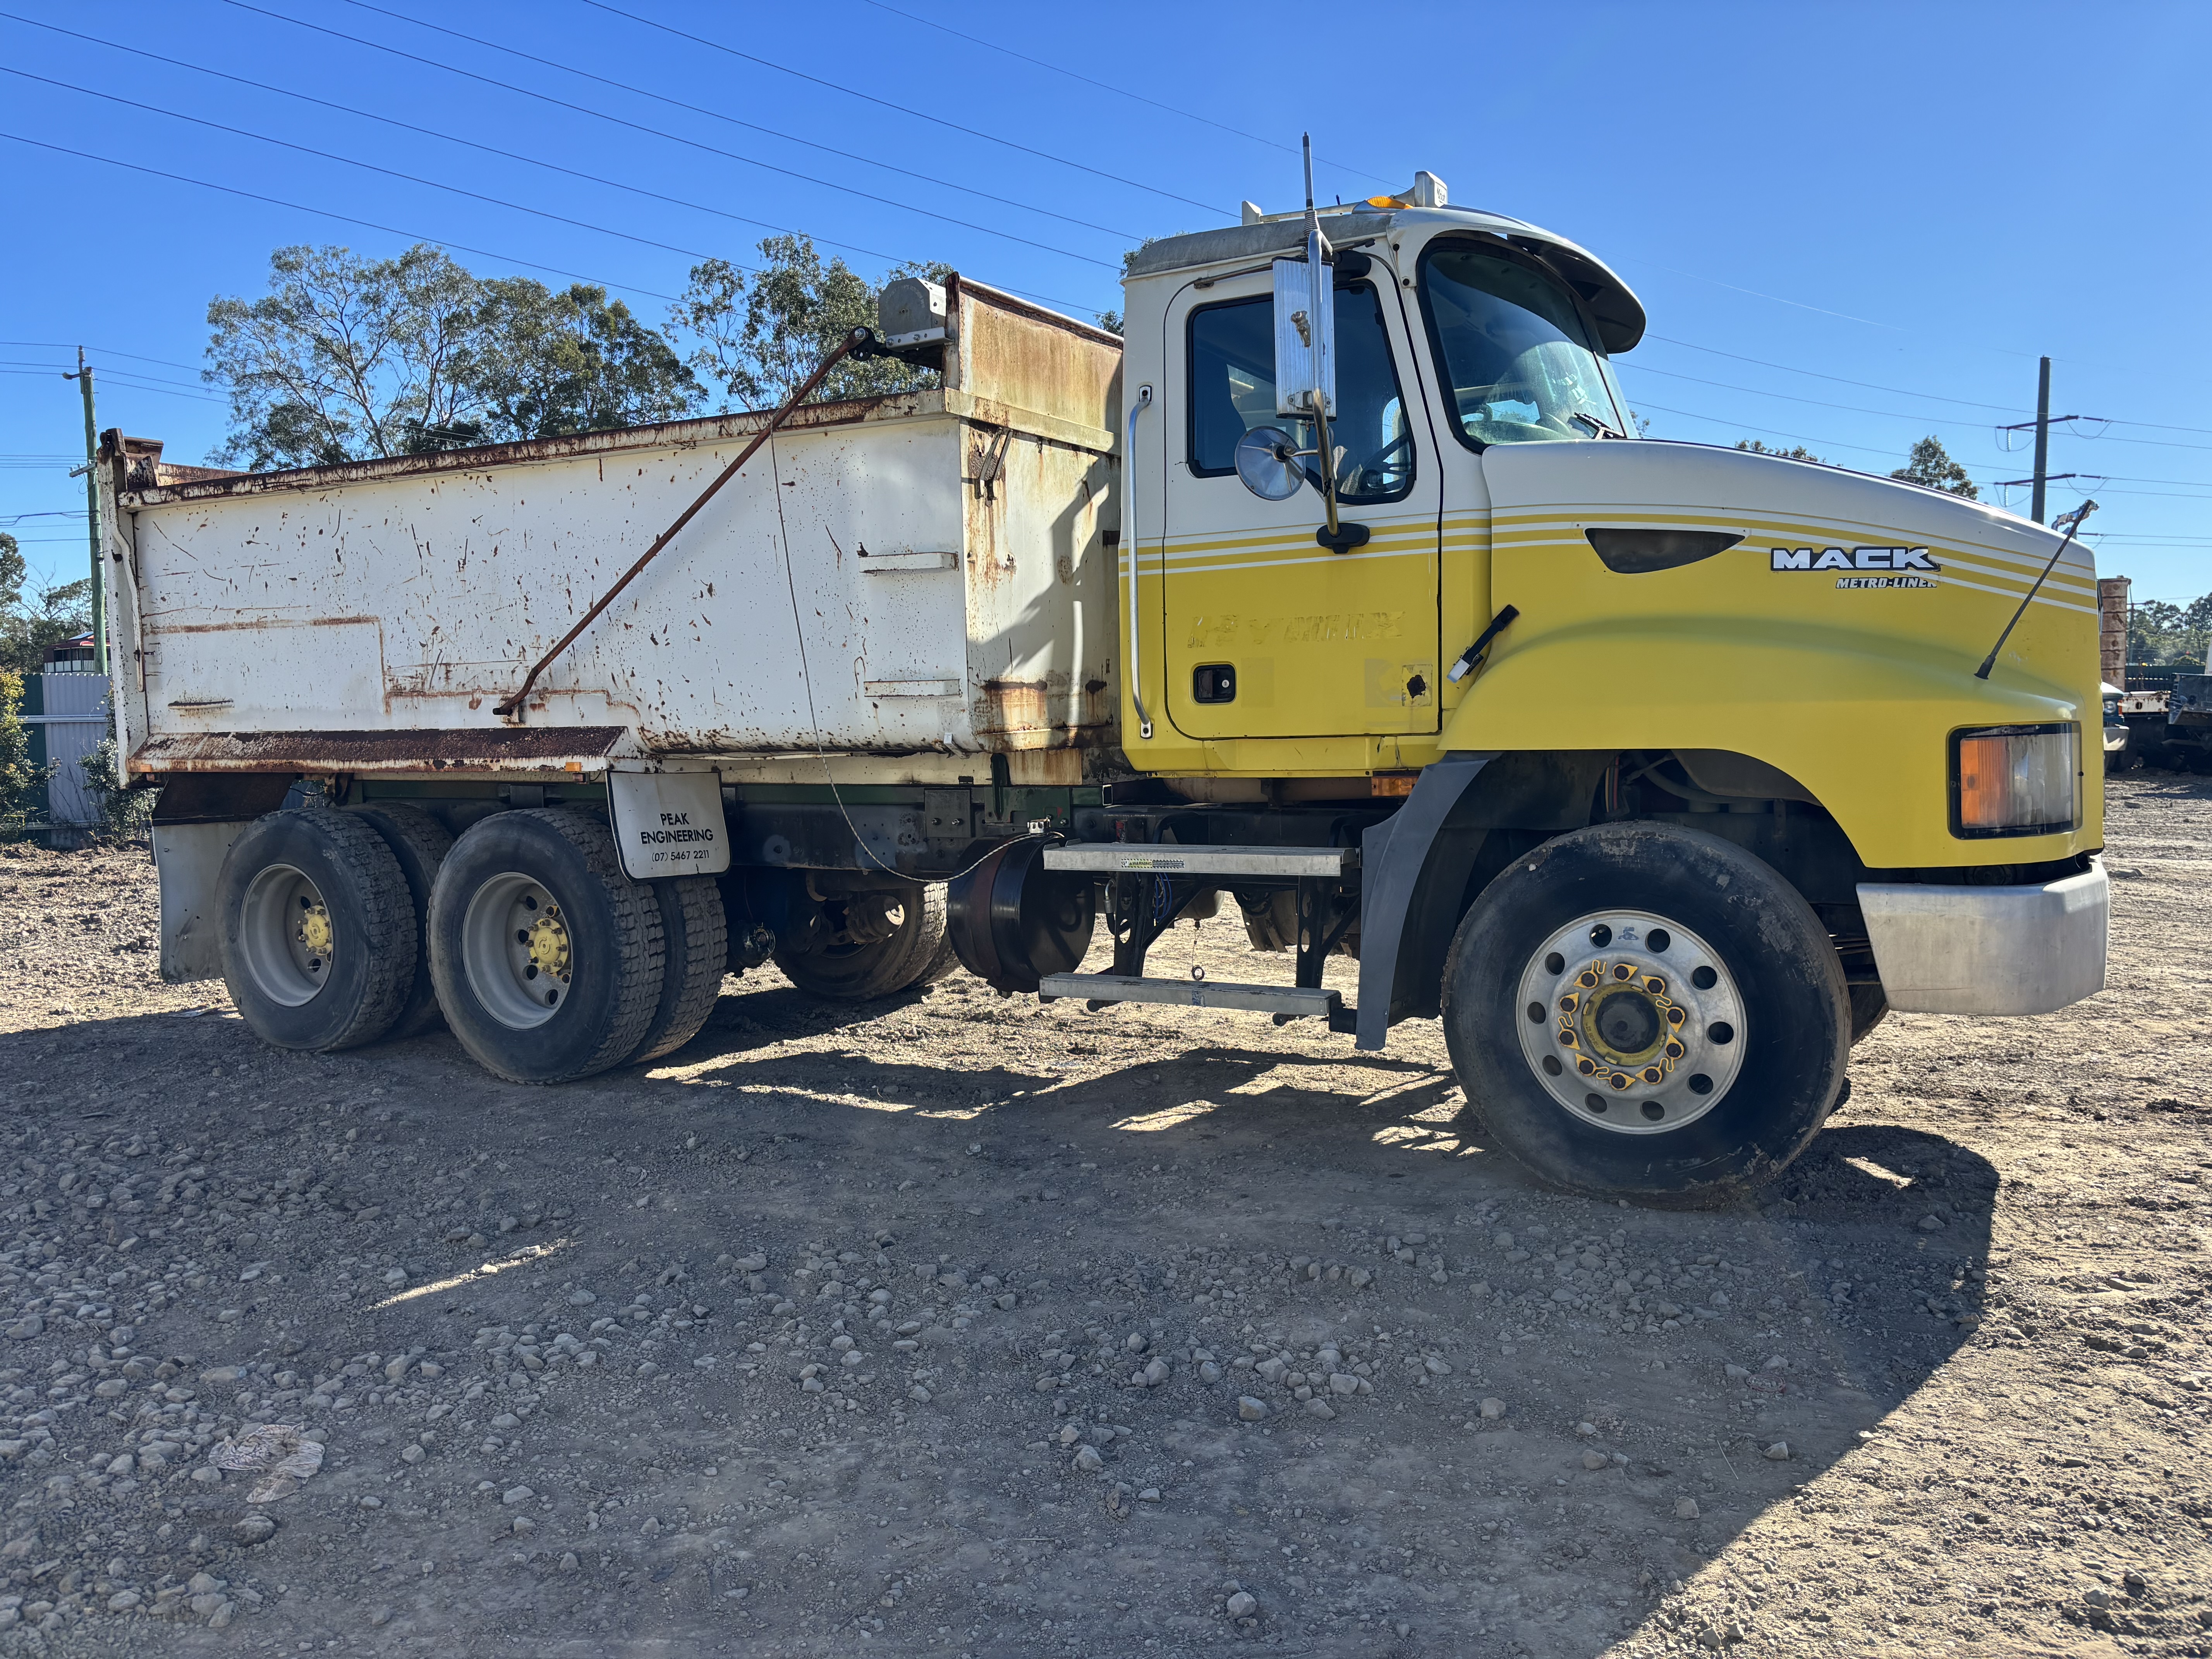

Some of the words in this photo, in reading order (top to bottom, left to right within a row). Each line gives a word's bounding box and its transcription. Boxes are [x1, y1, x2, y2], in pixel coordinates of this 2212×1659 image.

[1773, 548, 1934, 568] MACK
[660, 812, 690, 825] PEAK
[640, 829, 713, 844] ENGINEERING
[651, 852, 668, 862] (07)
[671, 851, 690, 860] 5467
[694, 850, 709, 859] 2211
